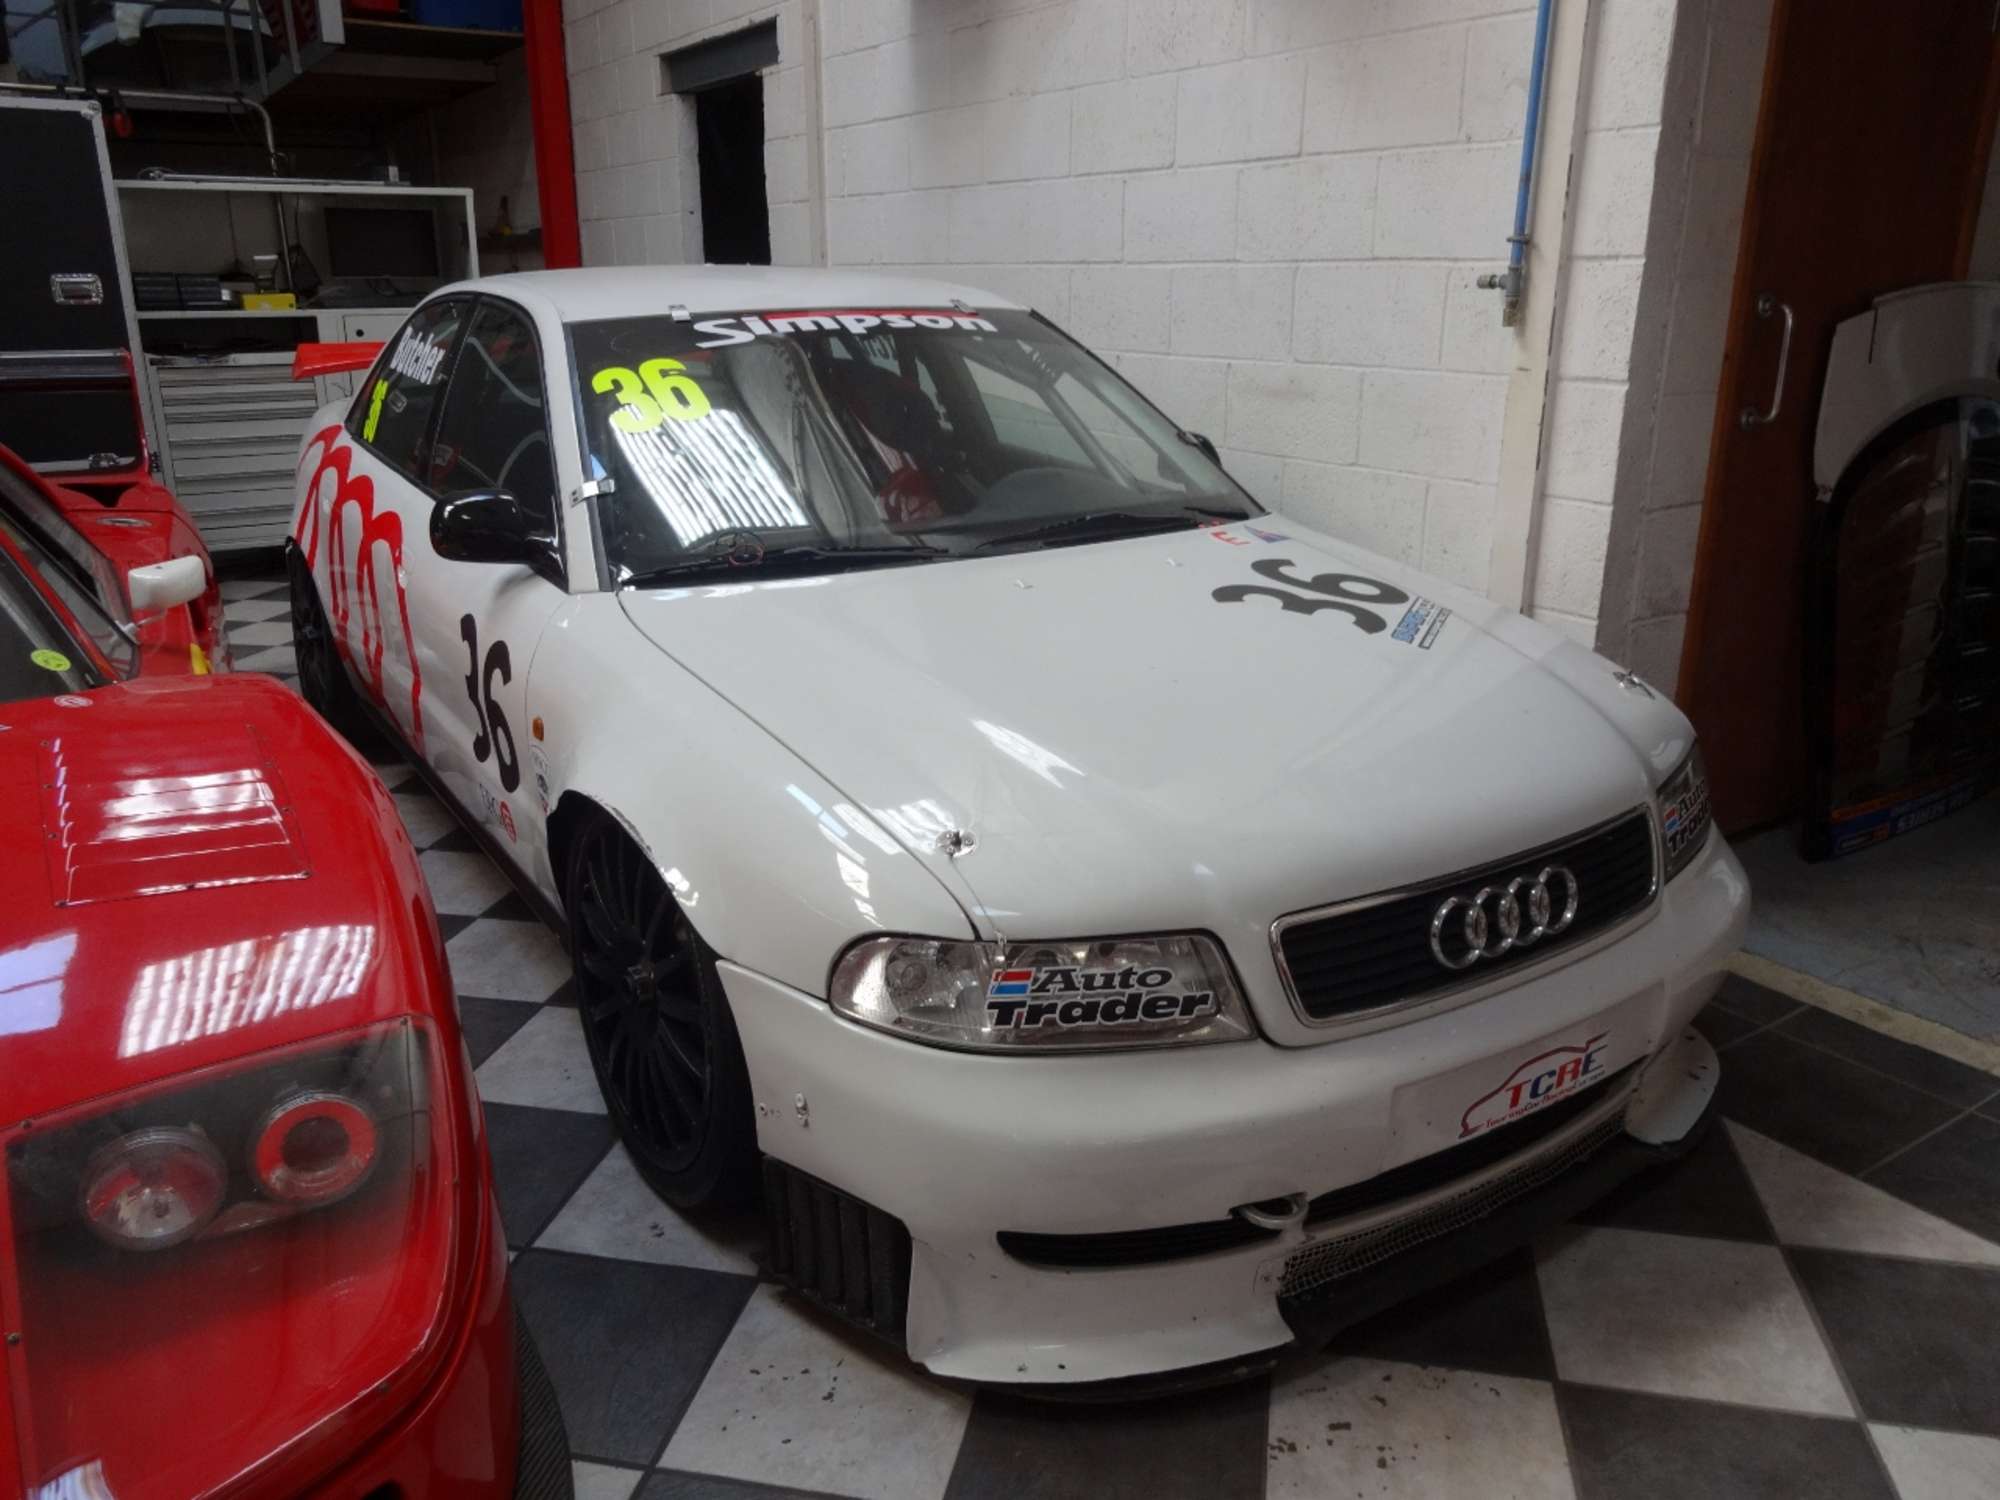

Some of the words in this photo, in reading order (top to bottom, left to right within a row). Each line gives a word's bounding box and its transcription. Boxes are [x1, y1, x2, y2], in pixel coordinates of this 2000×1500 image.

[693, 314, 997, 348] Simpson
[592, 358, 711, 433] 36
[1211, 558, 1410, 635] 36
[460, 613, 520, 793] 36
[1031, 966, 1174, 993] Auto
[986, 992, 1211, 1027] Trader
